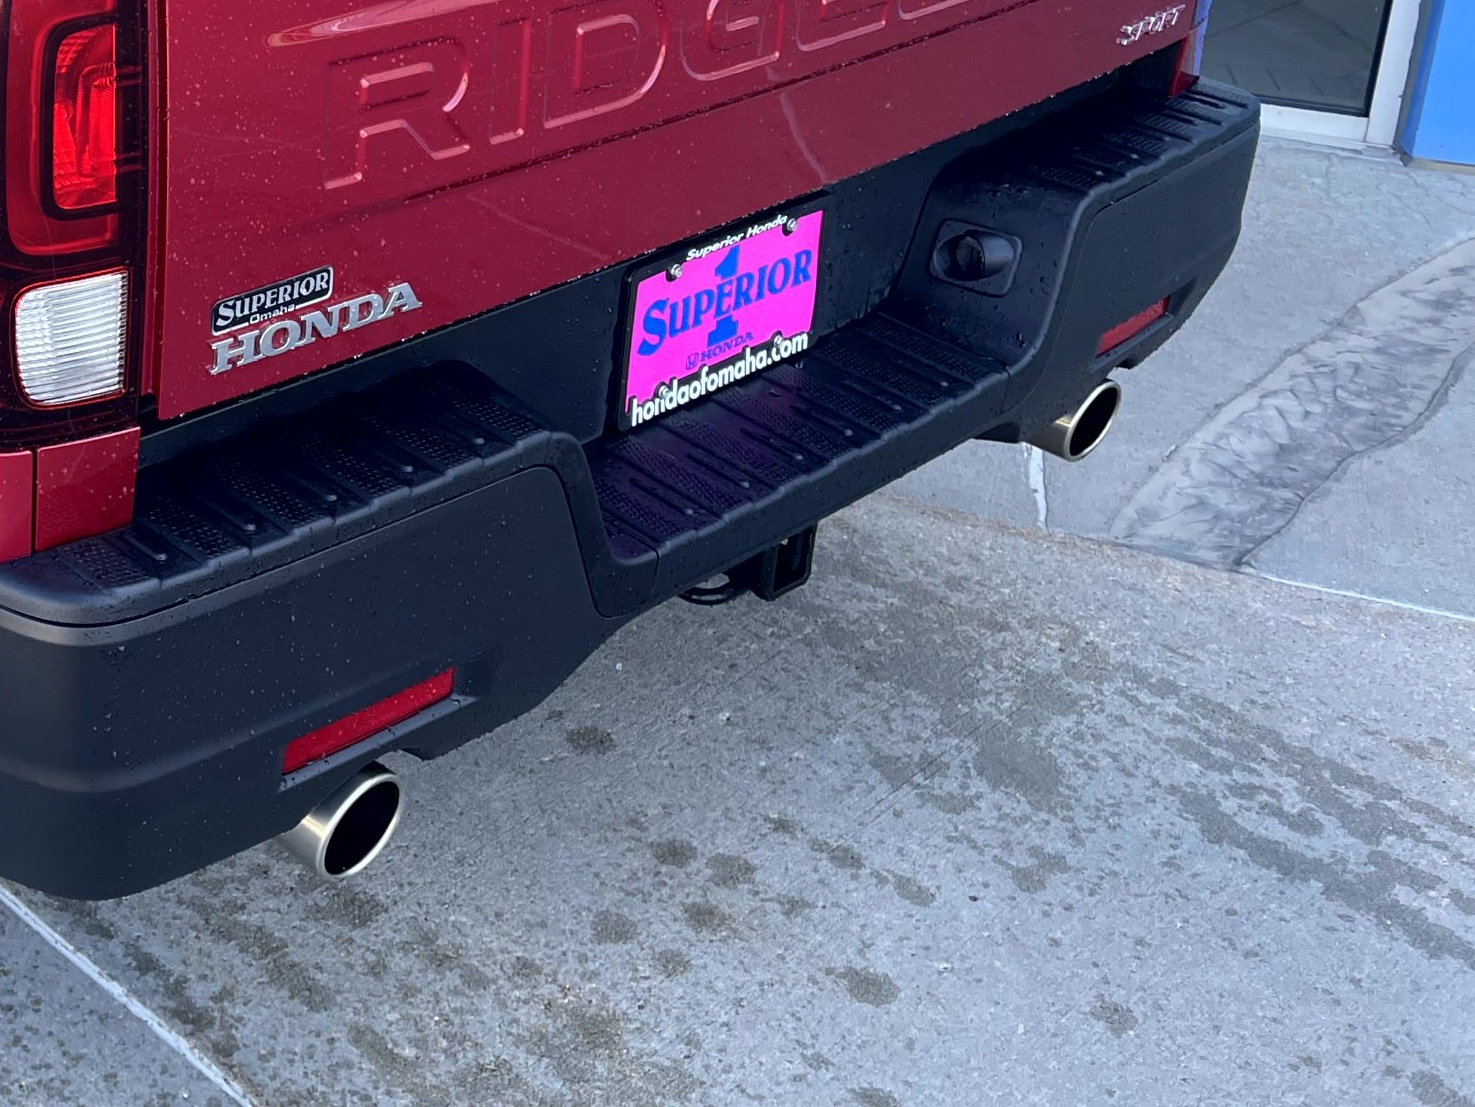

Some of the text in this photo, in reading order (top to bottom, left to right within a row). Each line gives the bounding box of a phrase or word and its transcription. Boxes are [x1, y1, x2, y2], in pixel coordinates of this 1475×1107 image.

[1116, 4, 1186, 46] SPORT
[685, 214, 789, 262] Superior Honda
[215, 271, 329, 327] SUPERIOR
[249, 303, 296, 324] Omaha
[637, 249, 813, 357] SUPERIOR
[209, 282, 423, 375] HONDA
[700, 331, 754, 362] HONDA
[631, 332, 809, 427] hondaofomaha.com
